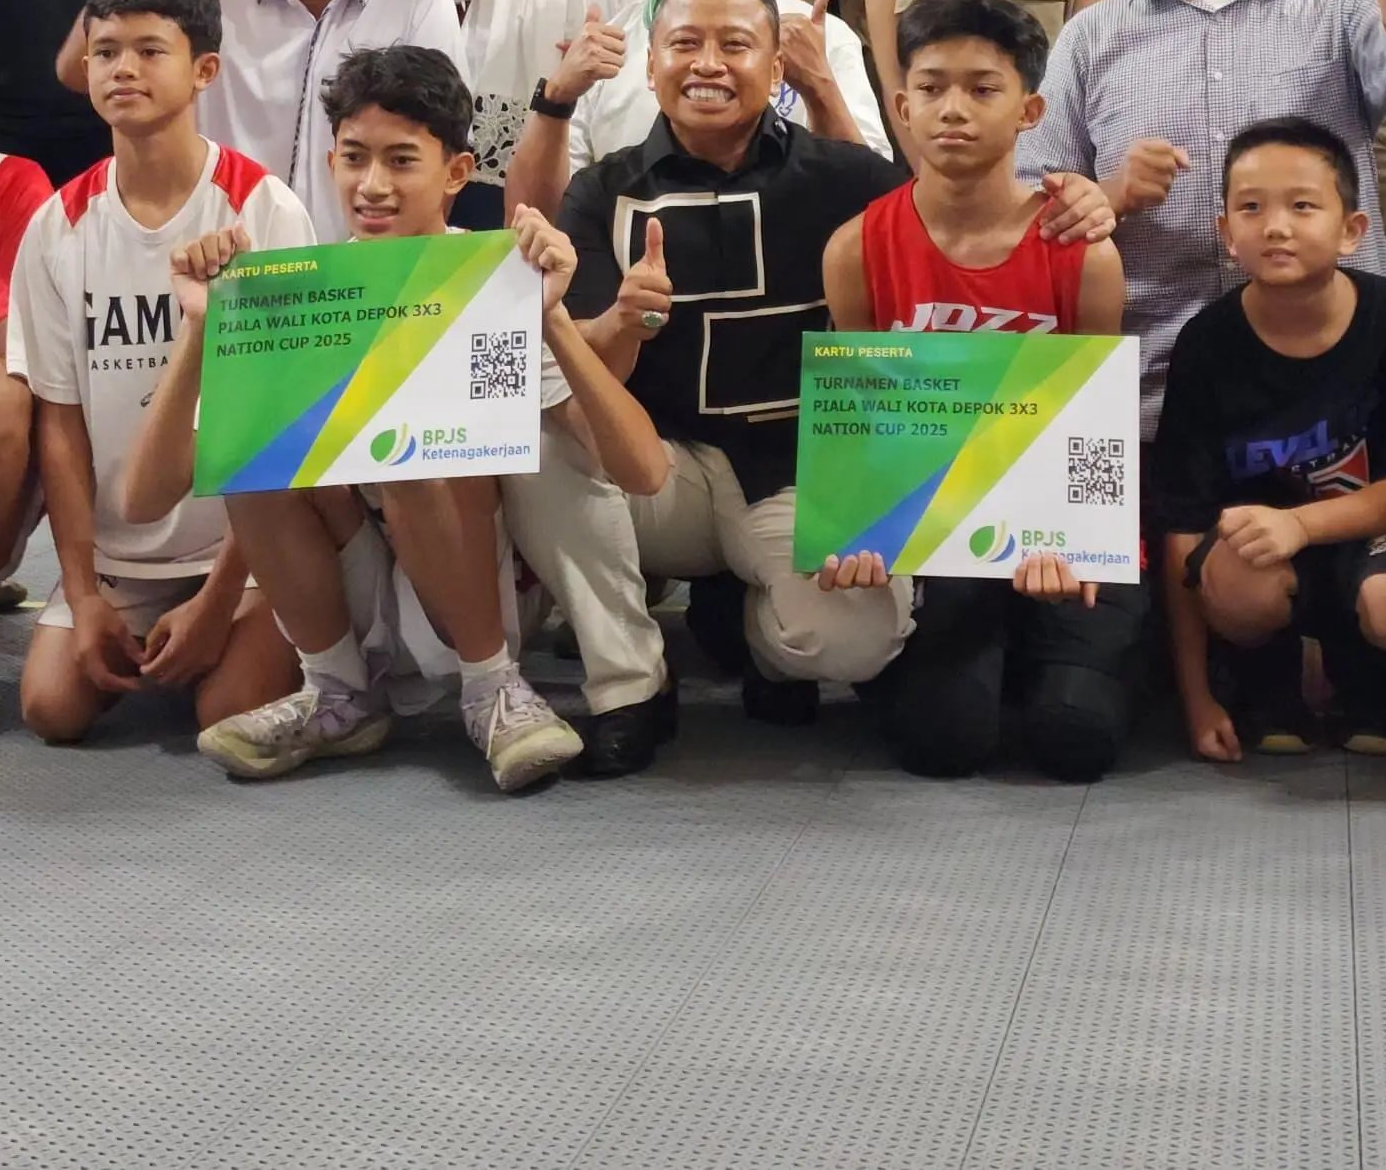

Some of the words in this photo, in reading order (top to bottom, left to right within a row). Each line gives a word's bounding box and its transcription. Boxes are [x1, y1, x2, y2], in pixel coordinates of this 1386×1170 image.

[221, 266, 261, 280] KARTU
[264, 260, 318, 276] PESERTA
[220, 292, 303, 312] TURNAMEN
[308, 286, 366, 304] BASKET
[218, 319, 262, 335] PIALA
[266, 314, 307, 329] WALI
[312, 310, 351, 326] KOTA
[356, 305, 408, 322] DEPOK
[413, 302, 442, 317] 3X3
[216, 339, 275, 358] NATION
[279, 336, 310, 352] CUP
[314, 333, 352, 348] 2025
[815, 347, 854, 358] KARTU
[858, 347, 913, 358] PESERTA
[91, 355, 169, 371] ASKETBA
[814, 377, 898, 391] TURNAMEN
[903, 378, 961, 391] BASKET
[813, 400, 856, 413] PIALA
[862, 400, 901, 413] WALI
[907, 401, 947, 414] KOTA
[953, 402, 1004, 415] DEPOK
[1009, 402, 1038, 416] 3X3
[422, 427, 467, 446] BPJS
[812, 422, 871, 436] NATION
[875, 423, 906, 436] CUP
[911, 423, 948, 436] 2025
[422, 442, 531, 461] Ketenagakerjaan
[1021, 529, 1066, 547] BPJS
[1021, 548, 1130, 566] Kagakerjaan
